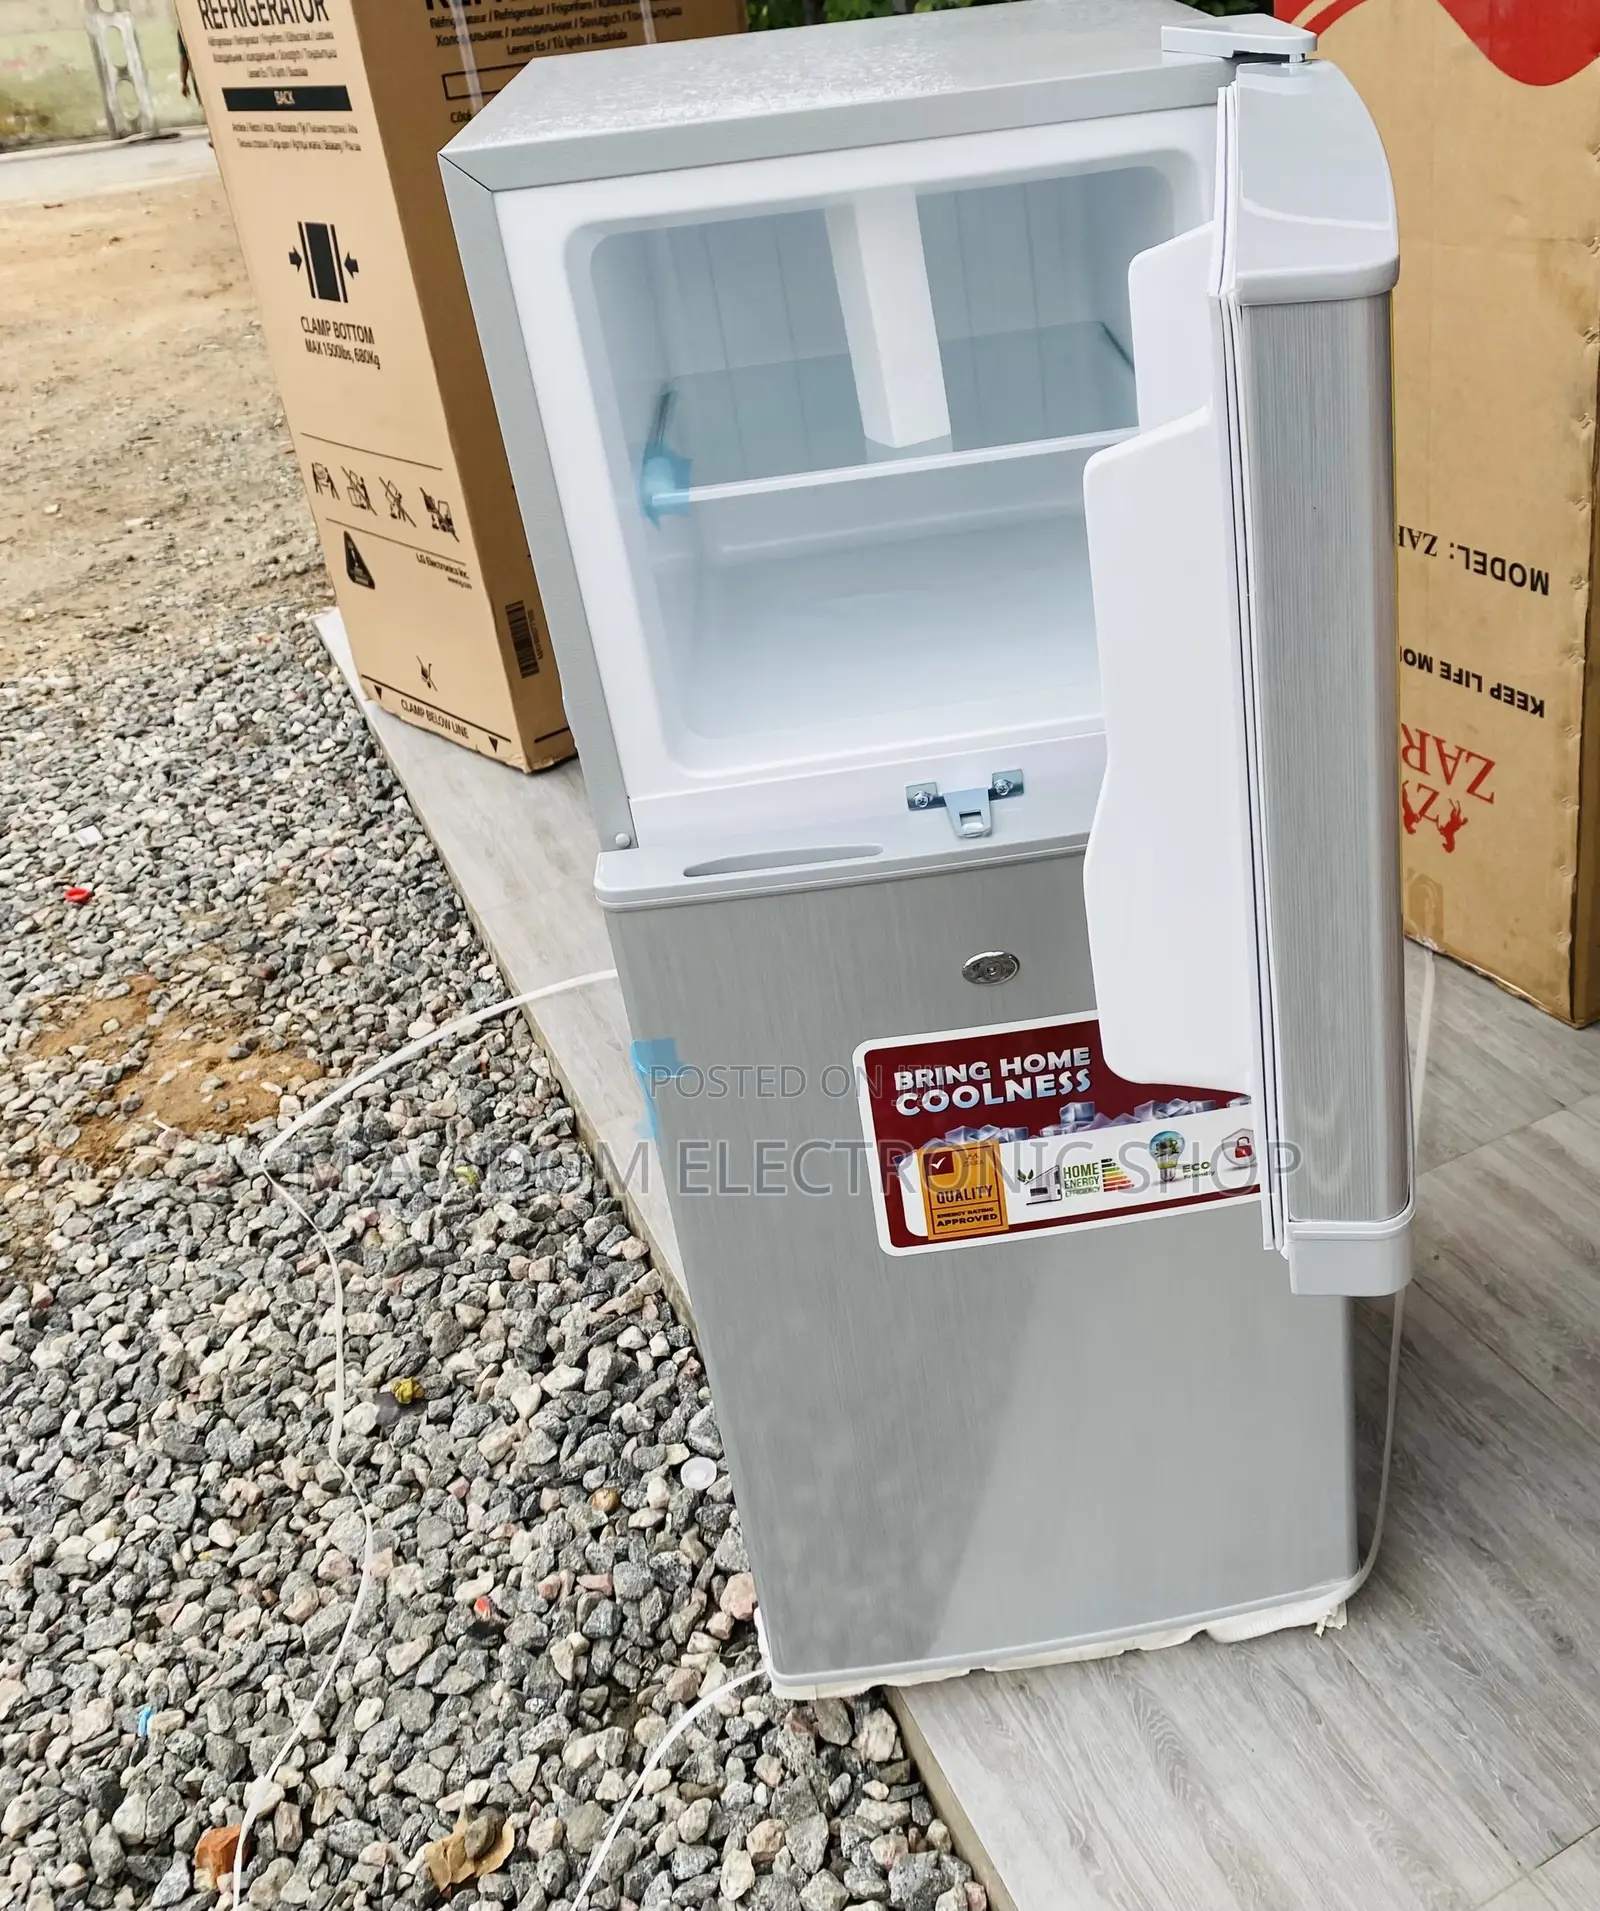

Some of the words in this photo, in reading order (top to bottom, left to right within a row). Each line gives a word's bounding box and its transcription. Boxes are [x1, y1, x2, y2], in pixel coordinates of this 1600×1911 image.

[274, 90, 295, 105] BACK
[300, 316, 331, 336] CLAMP
[332, 321, 375, 344] BOTTOM
[305, 338, 323, 355] MAX
[416, 553, 426, 564] LG
[426, 556, 459, 576] Electronics
[1449, 542, 1549, 595] MODEL:
[1400, 645, 1433, 674] MO
[1439, 660, 1483, 693] LIFE
[1490, 682, 1545, 718] KEEP
[401, 698, 424, 717] CLAMP
[426, 709, 451, 731] BELOW
[452, 721, 469, 739] LINE
[893, 1061, 991, 1091] BRING
[999, 1046, 1091, 1077] HOME
[895, 1068, 1091, 1116] COOLNESS
[1063, 1162, 1100, 1180] HOME
[1182, 1161, 1211, 1173] ECO
[1064, 1175, 1100, 1190] ENERGY
[936, 1185, 993, 1204] QUALITY
[936, 1210, 967, 1219] ENERGY
[967, 1207, 994, 1216] RATING
[936, 1213, 998, 1227] APPROVED
